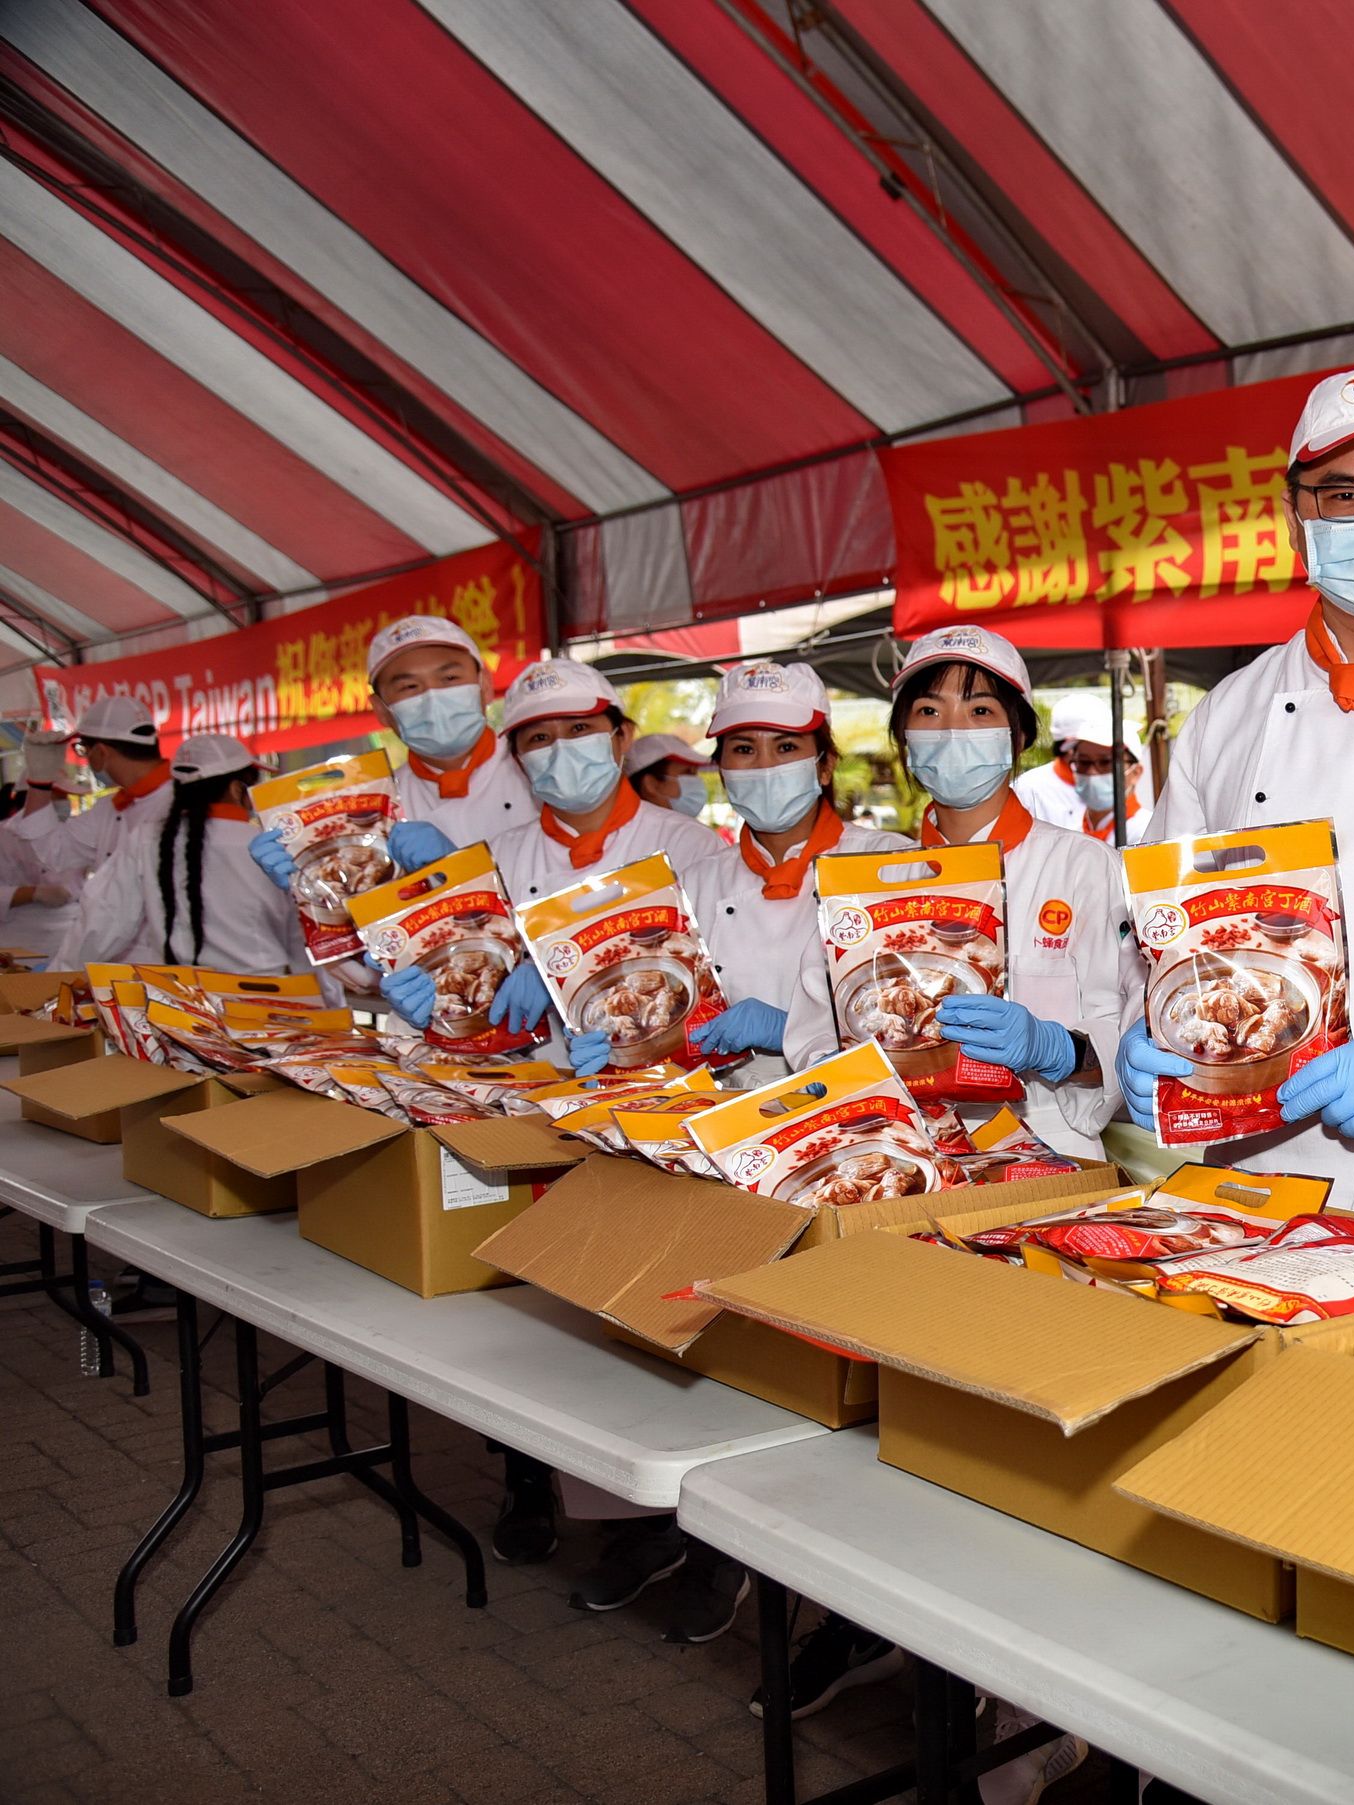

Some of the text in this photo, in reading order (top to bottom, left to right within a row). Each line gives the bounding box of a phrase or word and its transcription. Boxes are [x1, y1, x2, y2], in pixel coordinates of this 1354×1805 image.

[873, 901, 982, 923] 竹山紫南宮丁酒
[1190, 889, 1313, 918] 竹山紫南宮丁酒
[1042, 909, 1069, 925] CP
[772, 1099, 888, 1147] 竹山紫南宮丁酒
